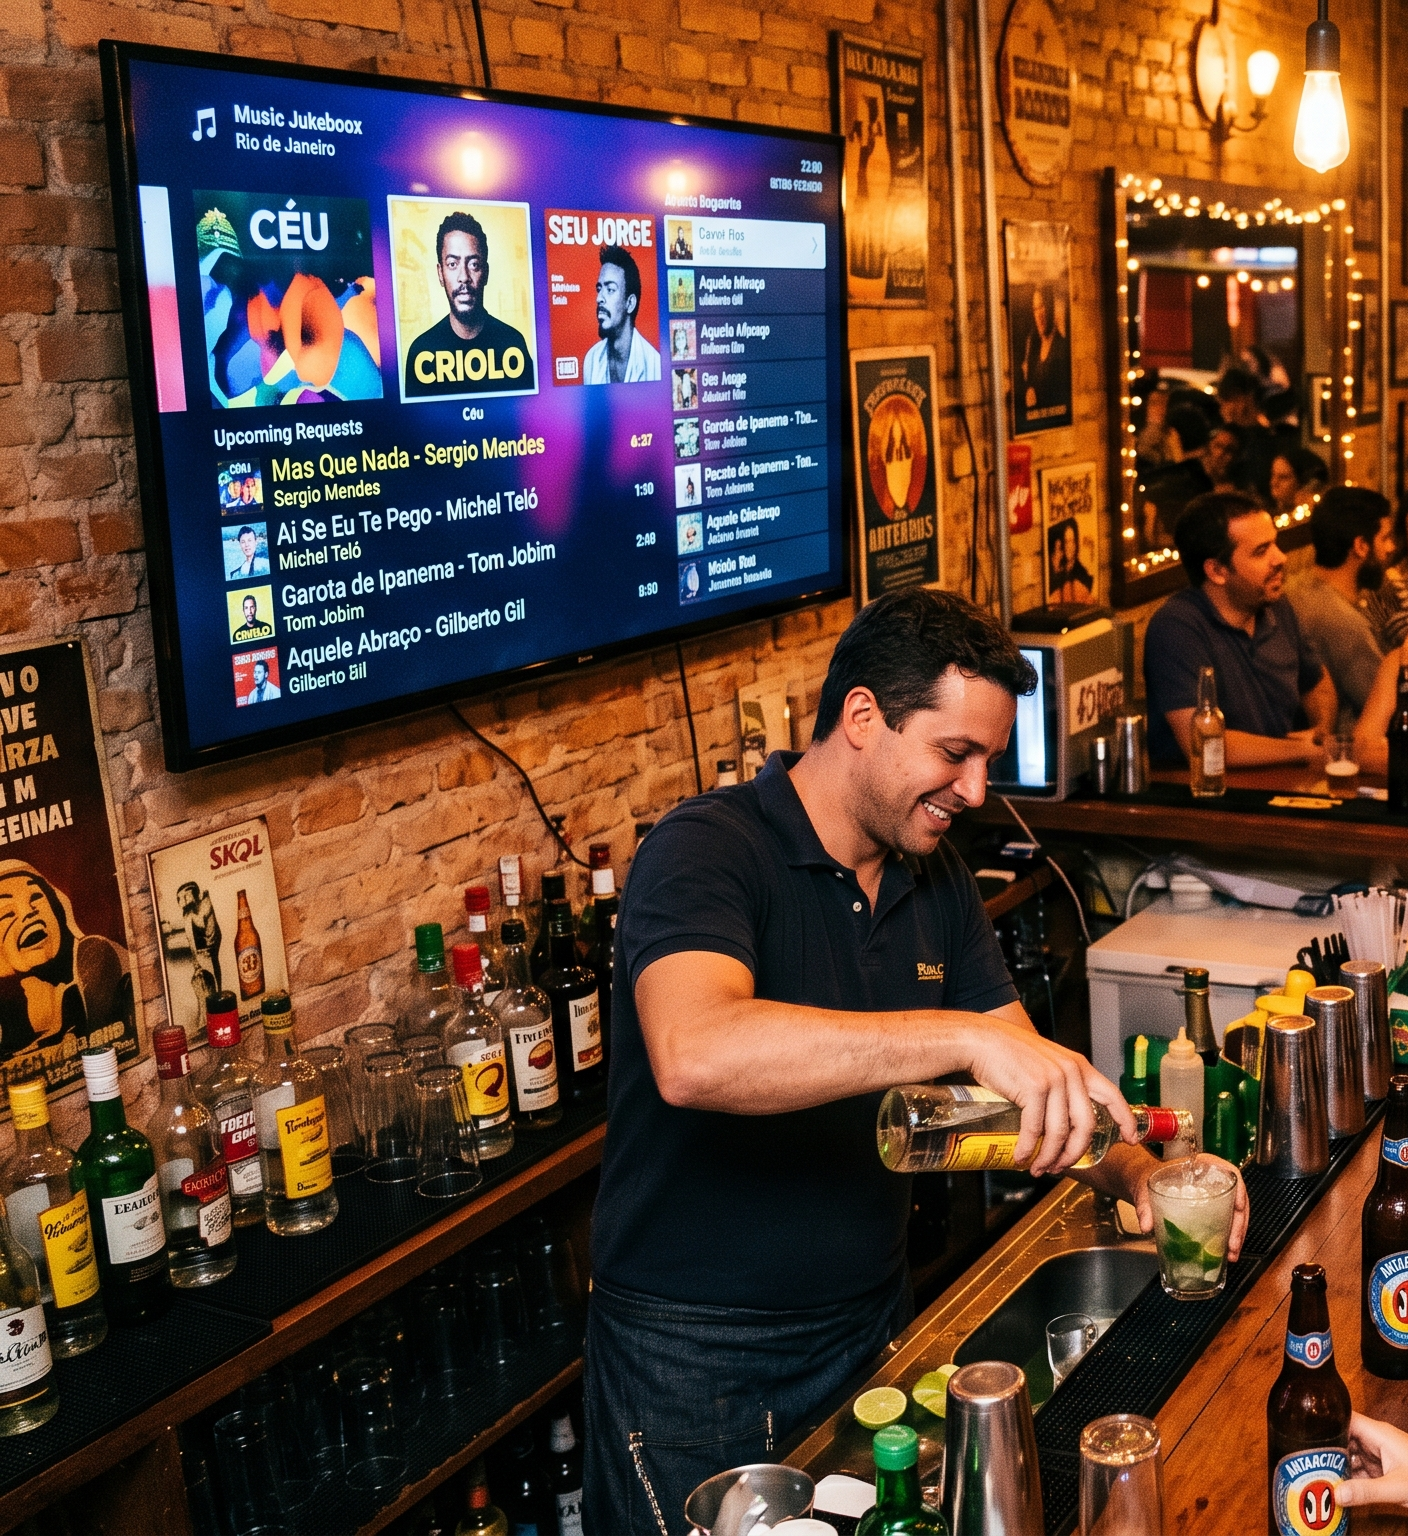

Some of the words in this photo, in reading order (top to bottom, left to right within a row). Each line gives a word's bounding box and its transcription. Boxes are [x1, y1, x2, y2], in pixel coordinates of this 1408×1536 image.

[234, 104, 285, 127] Music
[288, 111, 363, 135] Jukeboox
[236, 132, 260, 150] Rio
[263, 135, 281, 152] de
[284, 137, 336, 157] Janeiro
[250, 198, 329, 250] CÉU
[549, 215, 588, 246] SEU
[592, 218, 653, 247] JORGE
[414, 347, 525, 384] CRIOLO
[214, 424, 293, 450] Upcoming
[295, 419, 363, 442] Requests
[272, 457, 315, 482] Mas
[319, 453, 358, 479] Que
[361, 446, 410, 472] Nada
[424, 440, 479, 469] Sergio
[482, 433, 546, 460] Mendes
[274, 486, 321, 509] Sergio
[325, 479, 381, 502] Mendes
[277, 520, 297, 546] Ai
[301, 518, 327, 542] Se
[331, 515, 355, 538] Eu
[359, 511, 383, 533] Te
[386, 507, 432, 532] Pego
[446, 492, 502, 521] Michel
[504, 487, 539, 511] Teló
[279, 546, 328, 570] Michel
[331, 541, 362, 562] Teló
[282, 579, 347, 608] Garota
[351, 572, 375, 595] de
[379, 560, 455, 595] Ipanema
[467, 552, 504, 574] Tom
[508, 541, 556, 567] Jobim
[283, 615, 316, 633] Tom
[319, 604, 365, 627] Jobim
[286, 636, 353, 671] Aquele
[357, 625, 421, 656] Abraço
[436, 608, 501, 638] Gilberto
[504, 598, 526, 622] Gil
[288, 670, 346, 694] Gilberto
